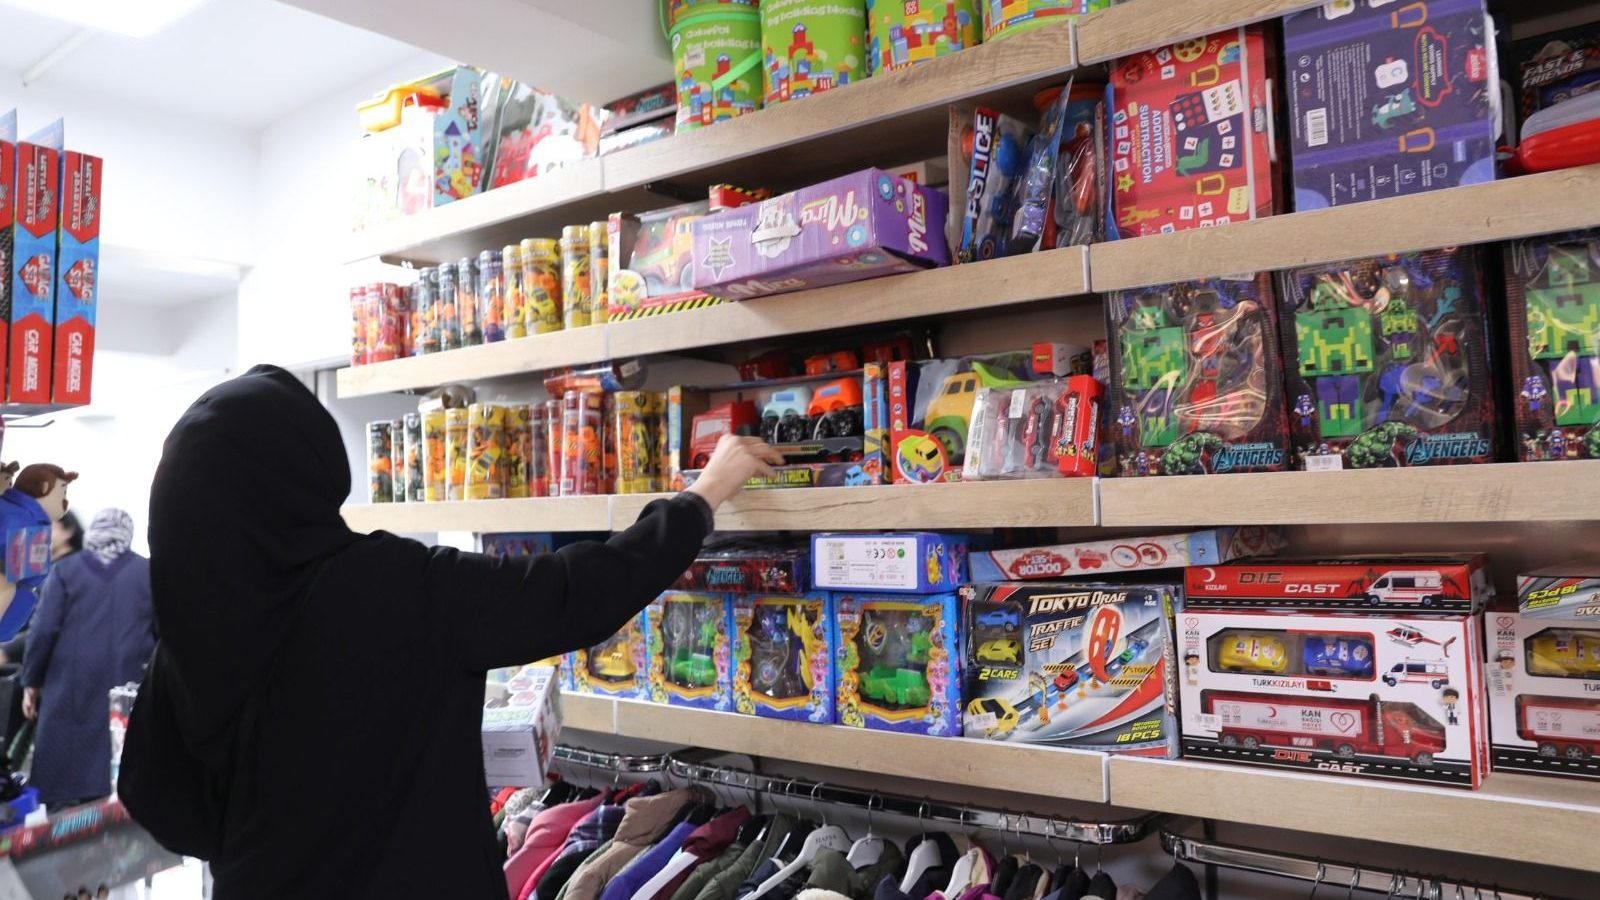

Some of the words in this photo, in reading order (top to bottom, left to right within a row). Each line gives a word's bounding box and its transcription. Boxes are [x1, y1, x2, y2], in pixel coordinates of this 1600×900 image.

[1522, 56, 1563, 79] FAST
[1522, 59, 1585, 88] FRIENDS
[1139, 104, 1152, 184] SUBTRACTION
[1152, 110, 1164, 163] ADDITION
[968, 113, 993, 219] POLICE
[1154, 165, 1164, 174] &
[799, 190, 860, 231] Mira
[907, 193, 928, 253] Mira
[28, 329, 39, 354] CAR
[71, 331, 83, 356] CAR
[1212, 446, 1284, 471] AVENGERS
[1405, 438, 1491, 464] AVENGERS
[783, 468, 811, 483] TRUCK
[1018, 562, 1061, 575] DOCTOR
[1237, 572, 1284, 584] DIE
[1284, 583, 1341, 594] CAST
[1527, 588, 1560, 600] PCS
[1561, 585, 1578, 595] 18
[1027, 592, 1093, 617] TOKYO
[1090, 590, 1129, 608] DRAG
[1030, 615, 1084, 638] TRAFFIC
[1496, 629, 1515, 637] KAN
[1029, 635, 1057, 652] SET
[978, 668, 990, 681] 2
[990, 669, 1019, 681] CARS
[1301, 709, 1321, 718] KAN
[1116, 732, 1132, 743] 18
[1131, 729, 1161, 741] PCS
[1273, 749, 1312, 763] DIE
[1317, 762, 1365, 774] CAST
